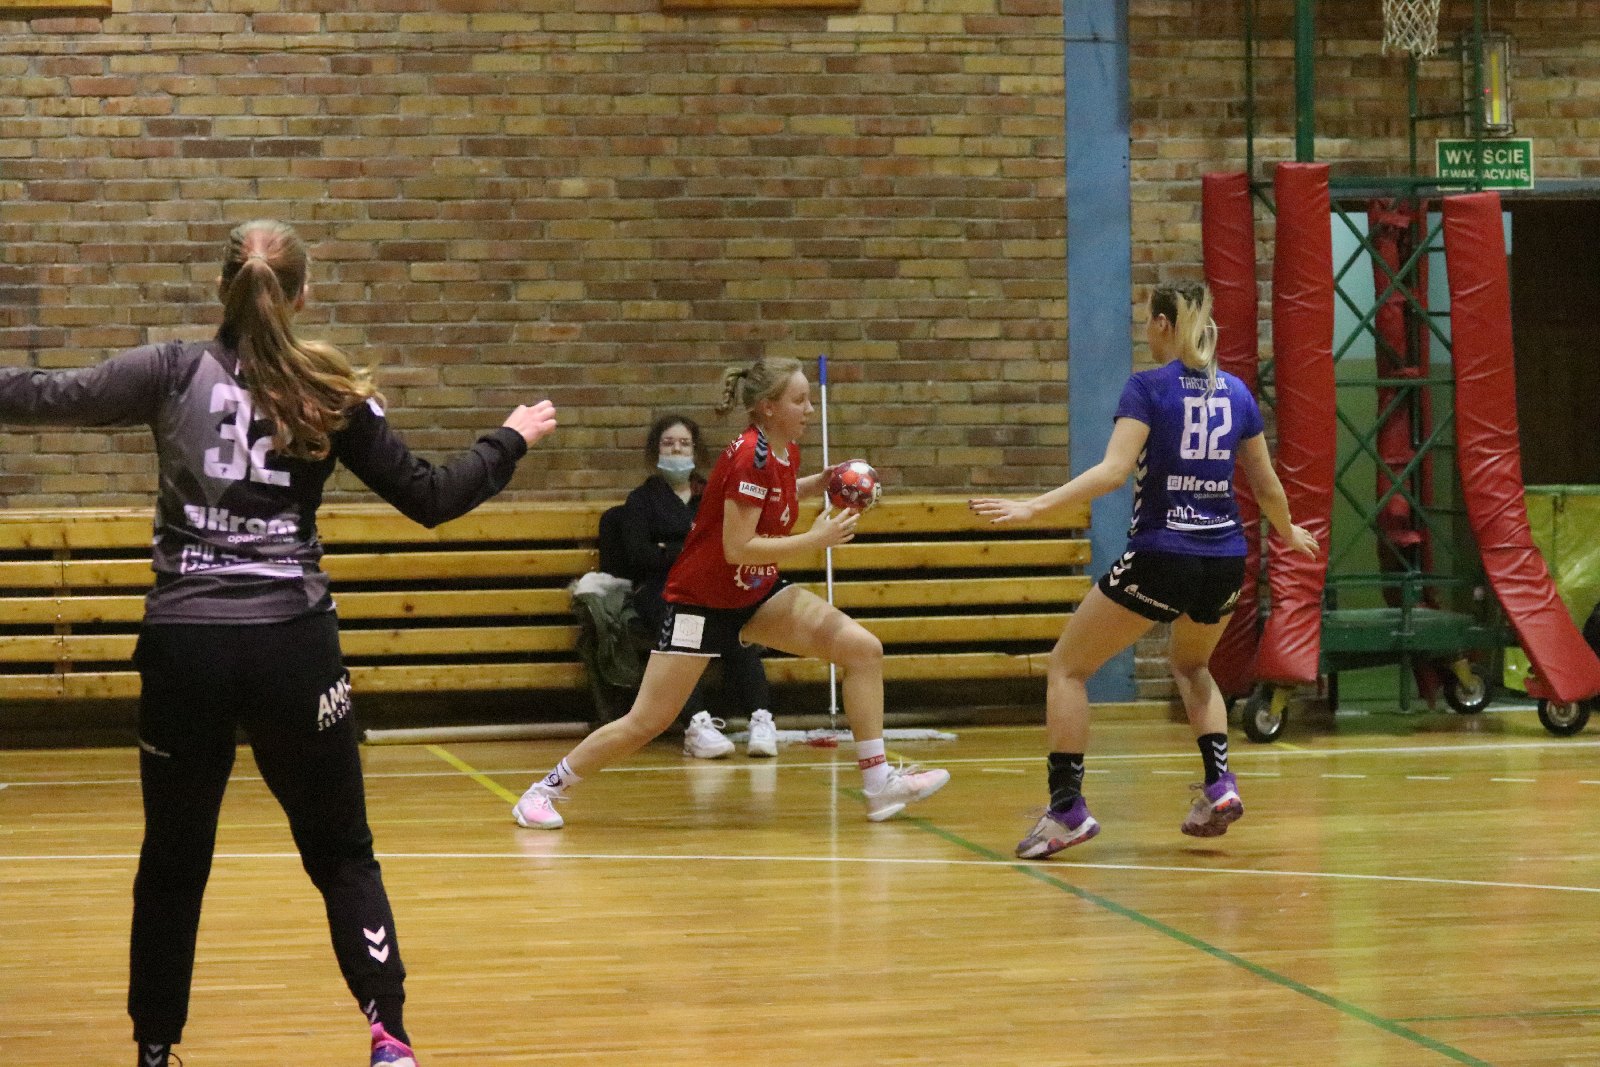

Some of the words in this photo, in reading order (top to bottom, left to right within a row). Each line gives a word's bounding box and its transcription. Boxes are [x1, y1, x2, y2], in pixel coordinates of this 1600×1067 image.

[1445, 147, 1525, 165] WYŚCIE
[1442, 168, 1528, 180] EWAKACYJNE
[204, 382, 290, 487] 32
[1180, 396, 1232, 460] 82
[780, 503, 791, 527] 4
